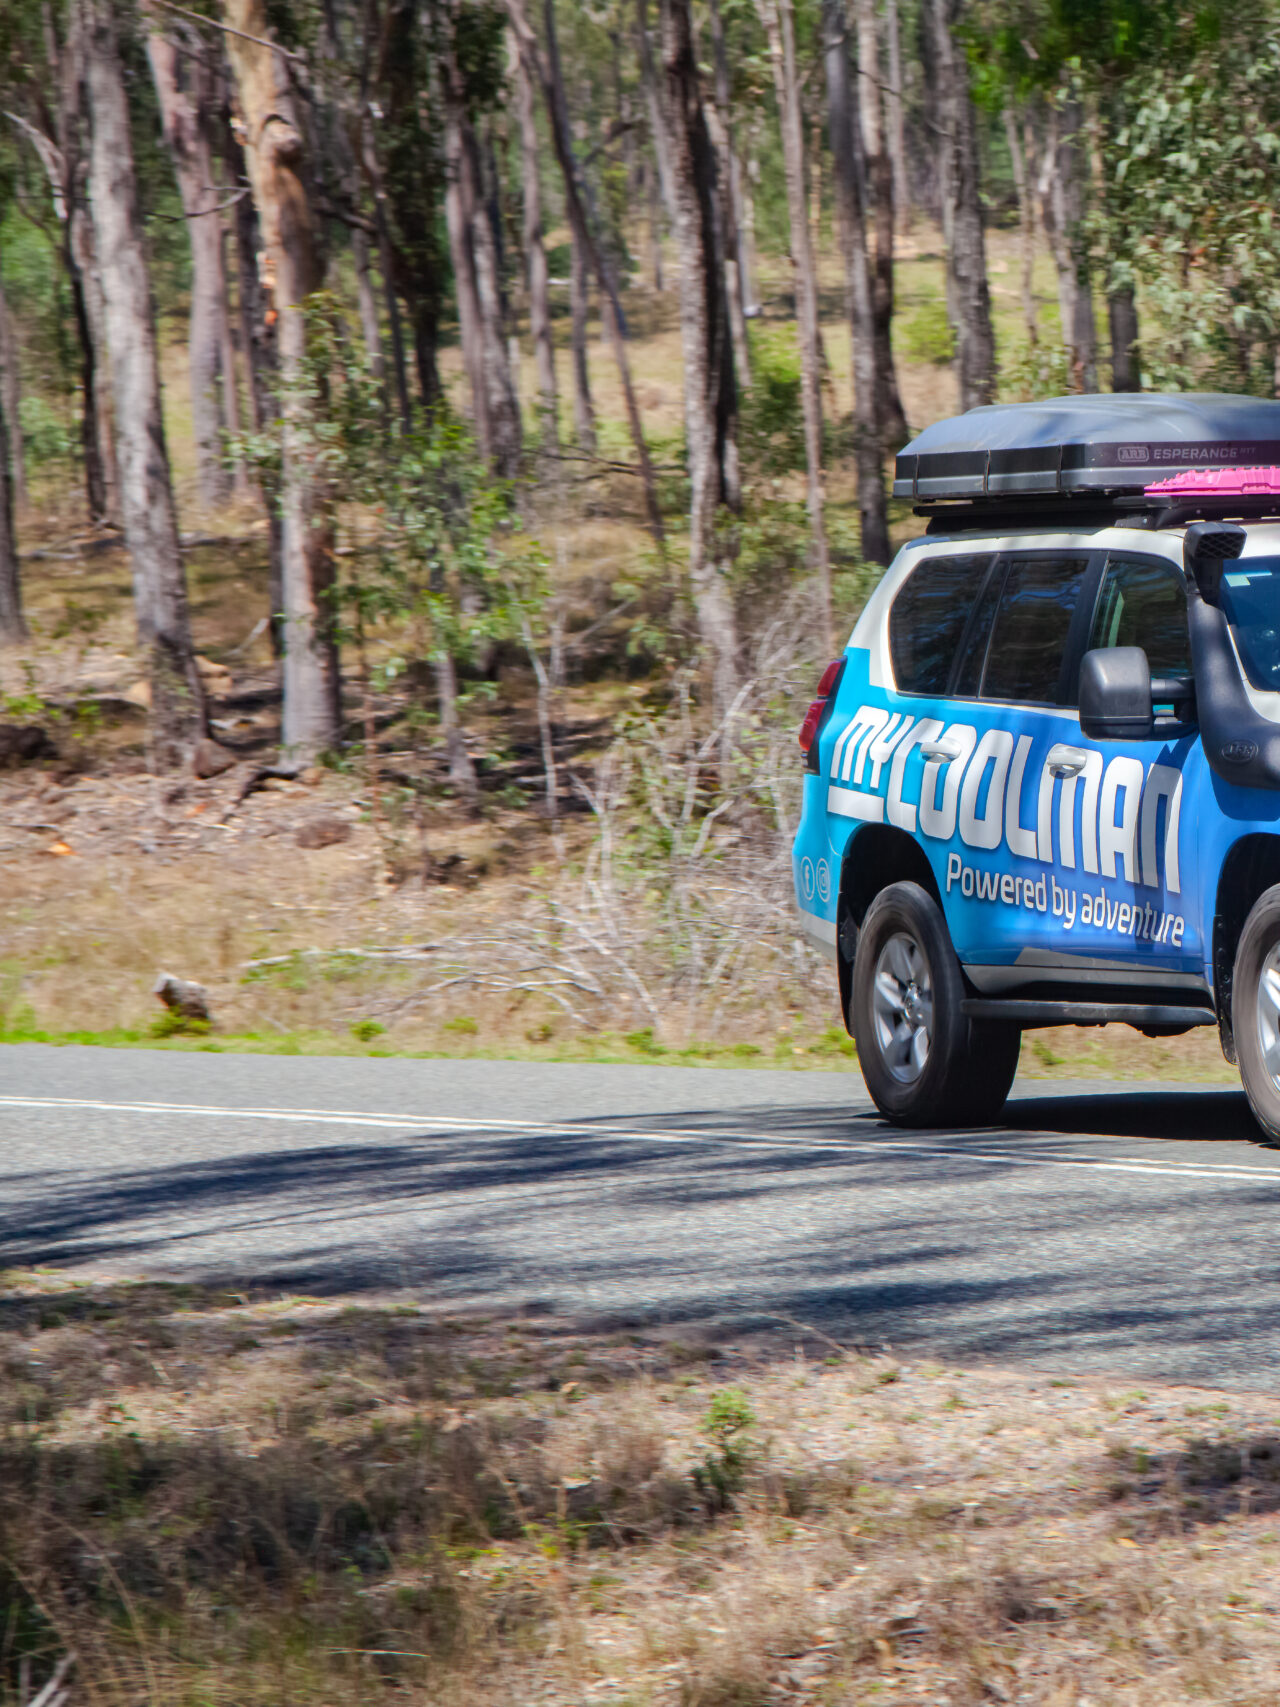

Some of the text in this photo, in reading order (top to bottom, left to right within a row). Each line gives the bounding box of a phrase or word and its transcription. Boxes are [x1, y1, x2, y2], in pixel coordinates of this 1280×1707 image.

[1120, 448, 1148, 461] ARB
[1153, 447, 1238, 460] ESPERANCE
[946, 852, 1185, 948] Powered by adventure
